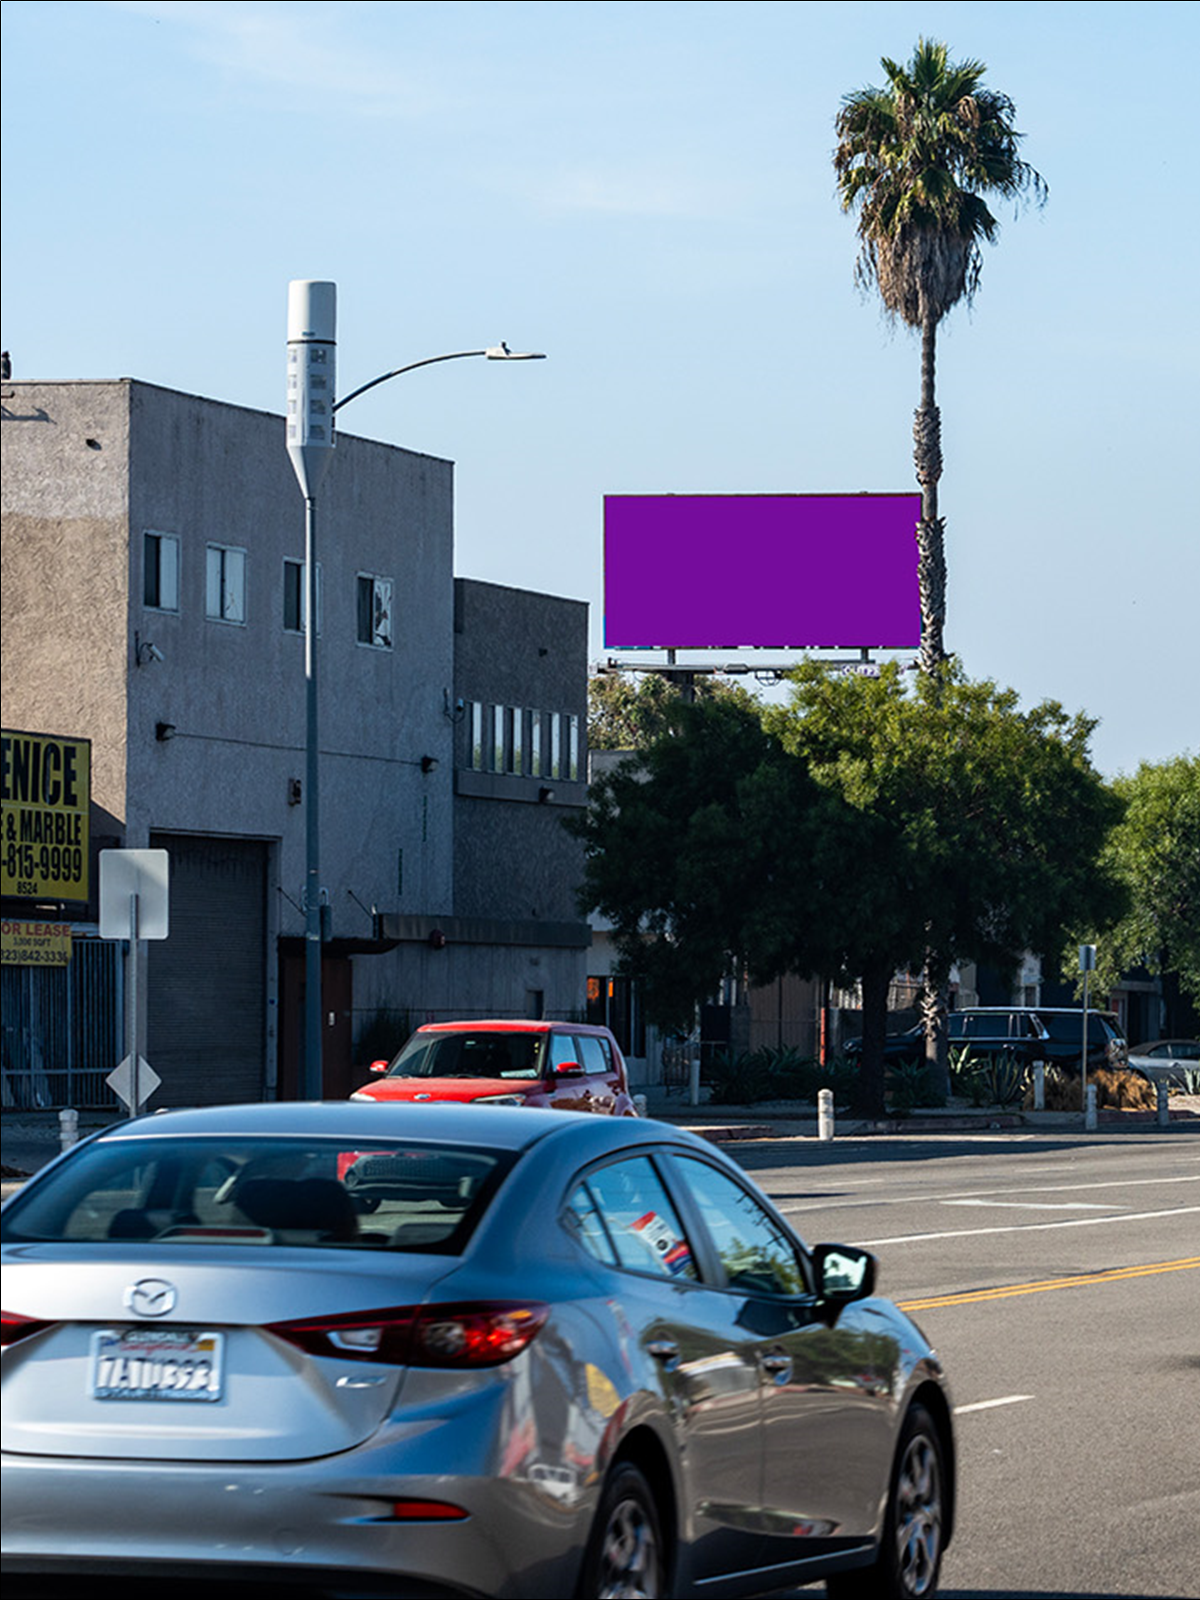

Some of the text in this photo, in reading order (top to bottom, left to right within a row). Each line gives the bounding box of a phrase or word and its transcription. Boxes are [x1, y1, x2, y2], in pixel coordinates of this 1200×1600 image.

[6, 812, 17, 841] &
[20, 808, 82, 846] MARBLE
[17, 881, 38, 895] 8524
[26, 923, 71, 938] LEASE
